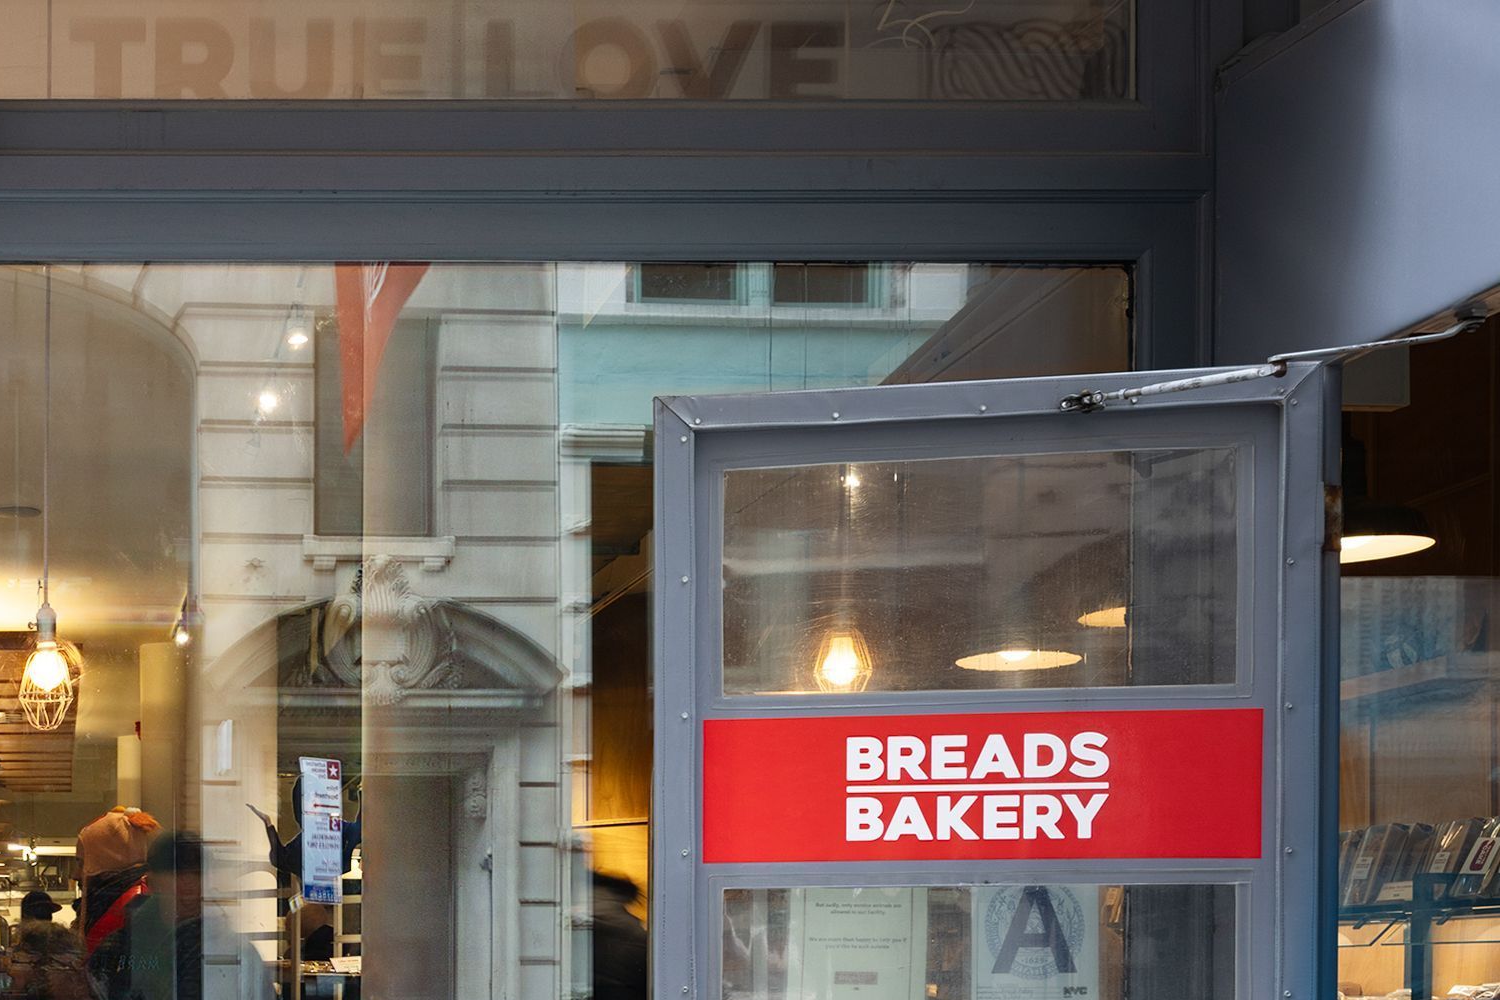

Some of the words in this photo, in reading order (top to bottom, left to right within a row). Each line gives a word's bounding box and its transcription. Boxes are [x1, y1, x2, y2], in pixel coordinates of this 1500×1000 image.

[69, 17, 426, 98] TRUE
[485, 17, 845, 98] LOVE
[845, 731, 1110, 782] BREADS
[845, 793, 1110, 842] BAKERY
[991, 885, 1078, 974] A
